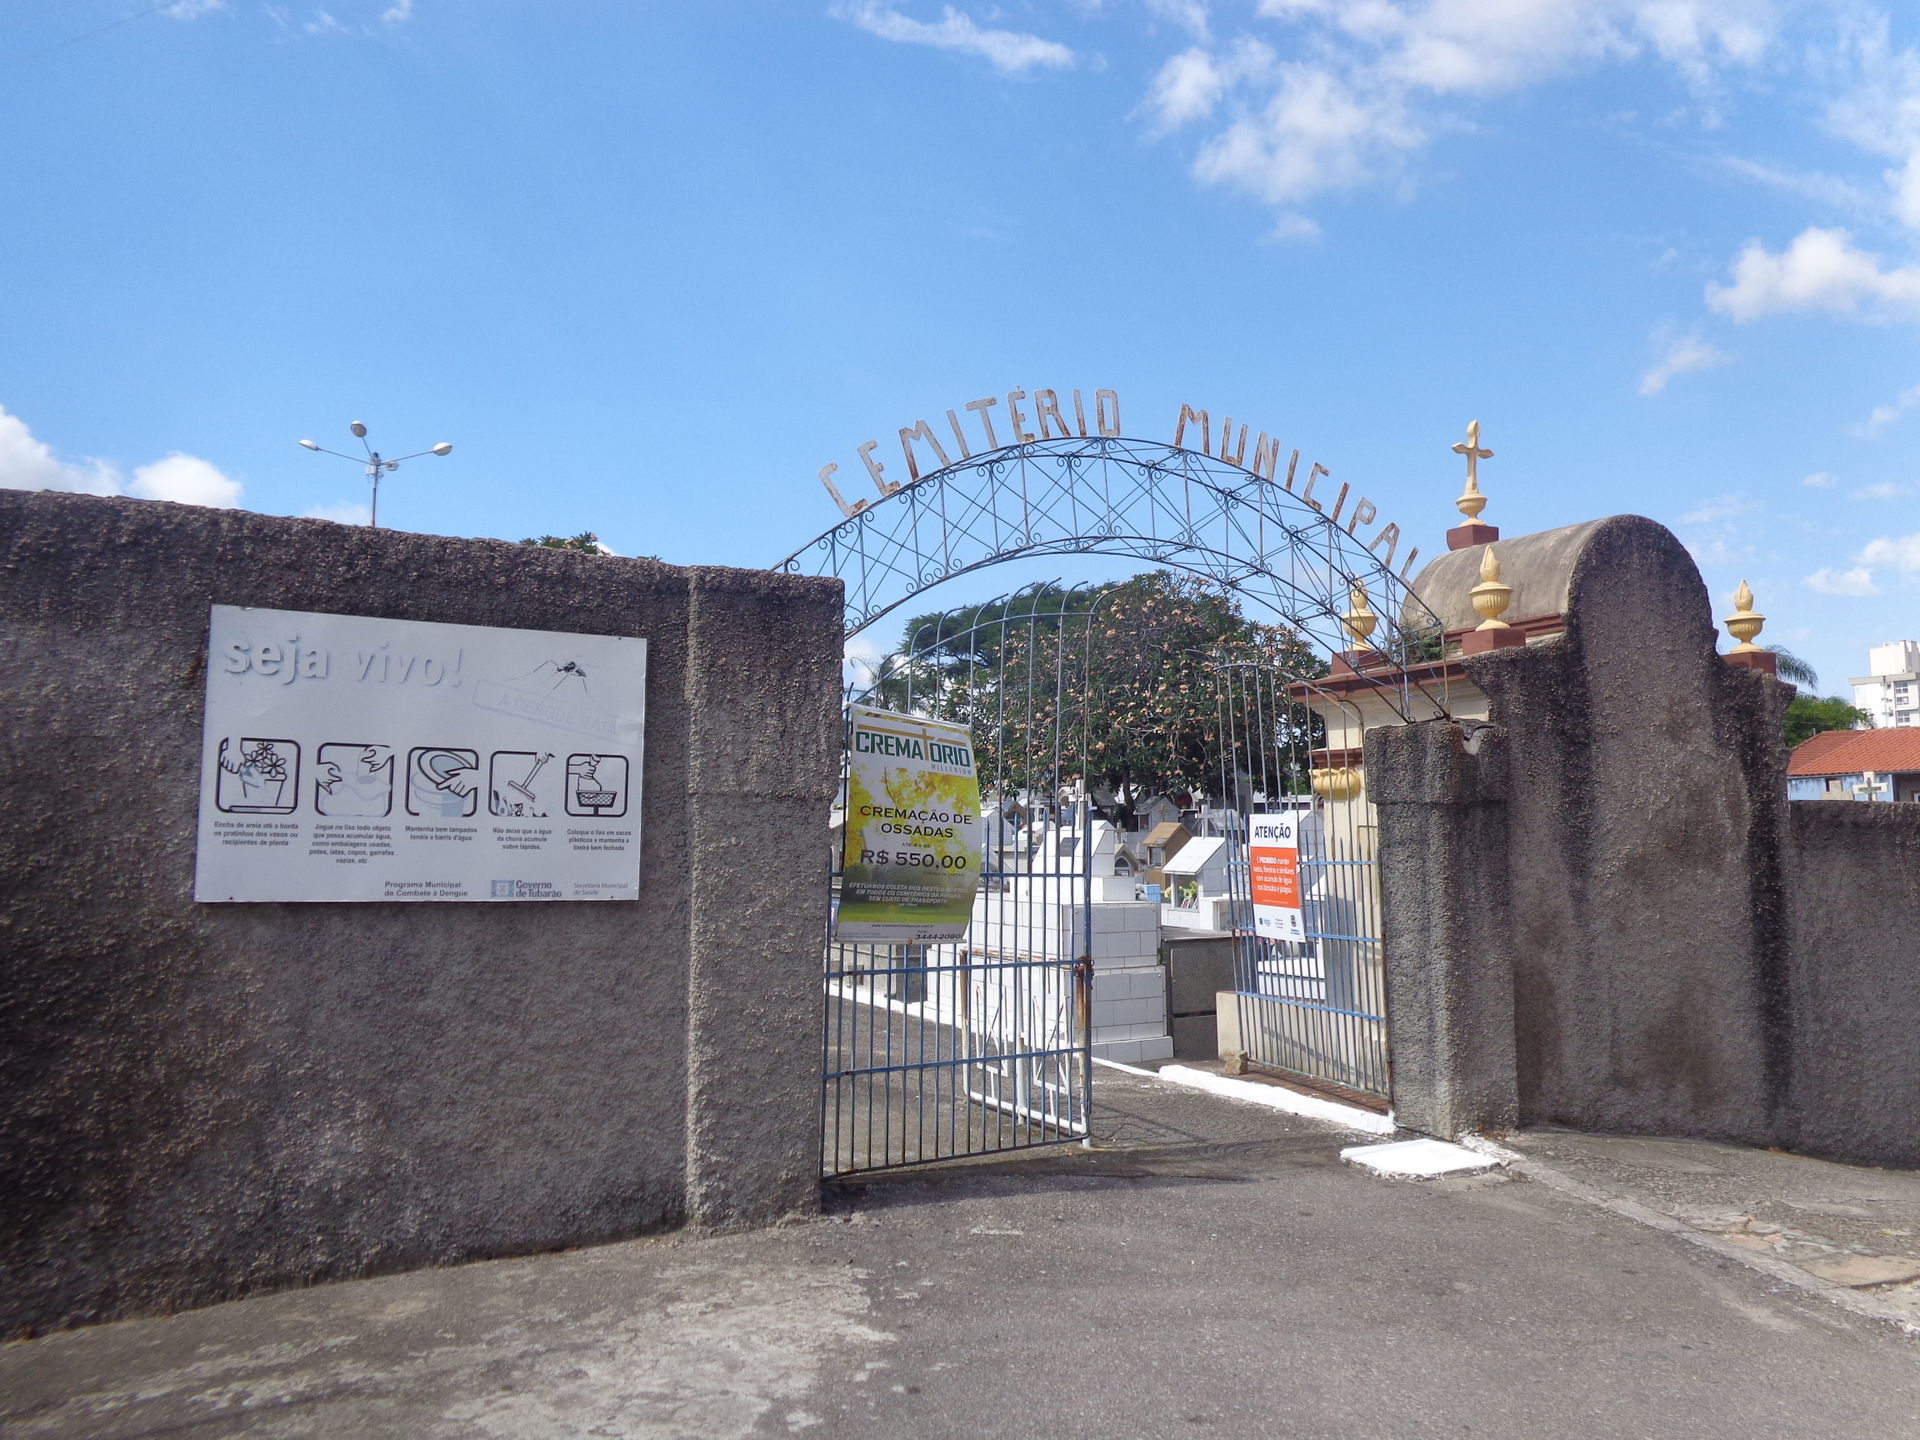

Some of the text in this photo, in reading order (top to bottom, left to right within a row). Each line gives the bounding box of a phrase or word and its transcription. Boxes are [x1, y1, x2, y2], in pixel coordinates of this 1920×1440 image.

[1174, 403, 1418, 592] MUNICIPAL
[223, 632, 463, 688] seja vivo!
[860, 805, 973, 825] CREMAÇÃO DE
[881, 823, 954, 838] OSSADAS
[1254, 823, 1291, 842] ATENÇÃO
[860, 849, 967, 870] R$ 550,00
[384, 881, 461, 889] Programa Municipal
[515, 880, 552, 889] Governo
[515, 889, 527, 897] de
